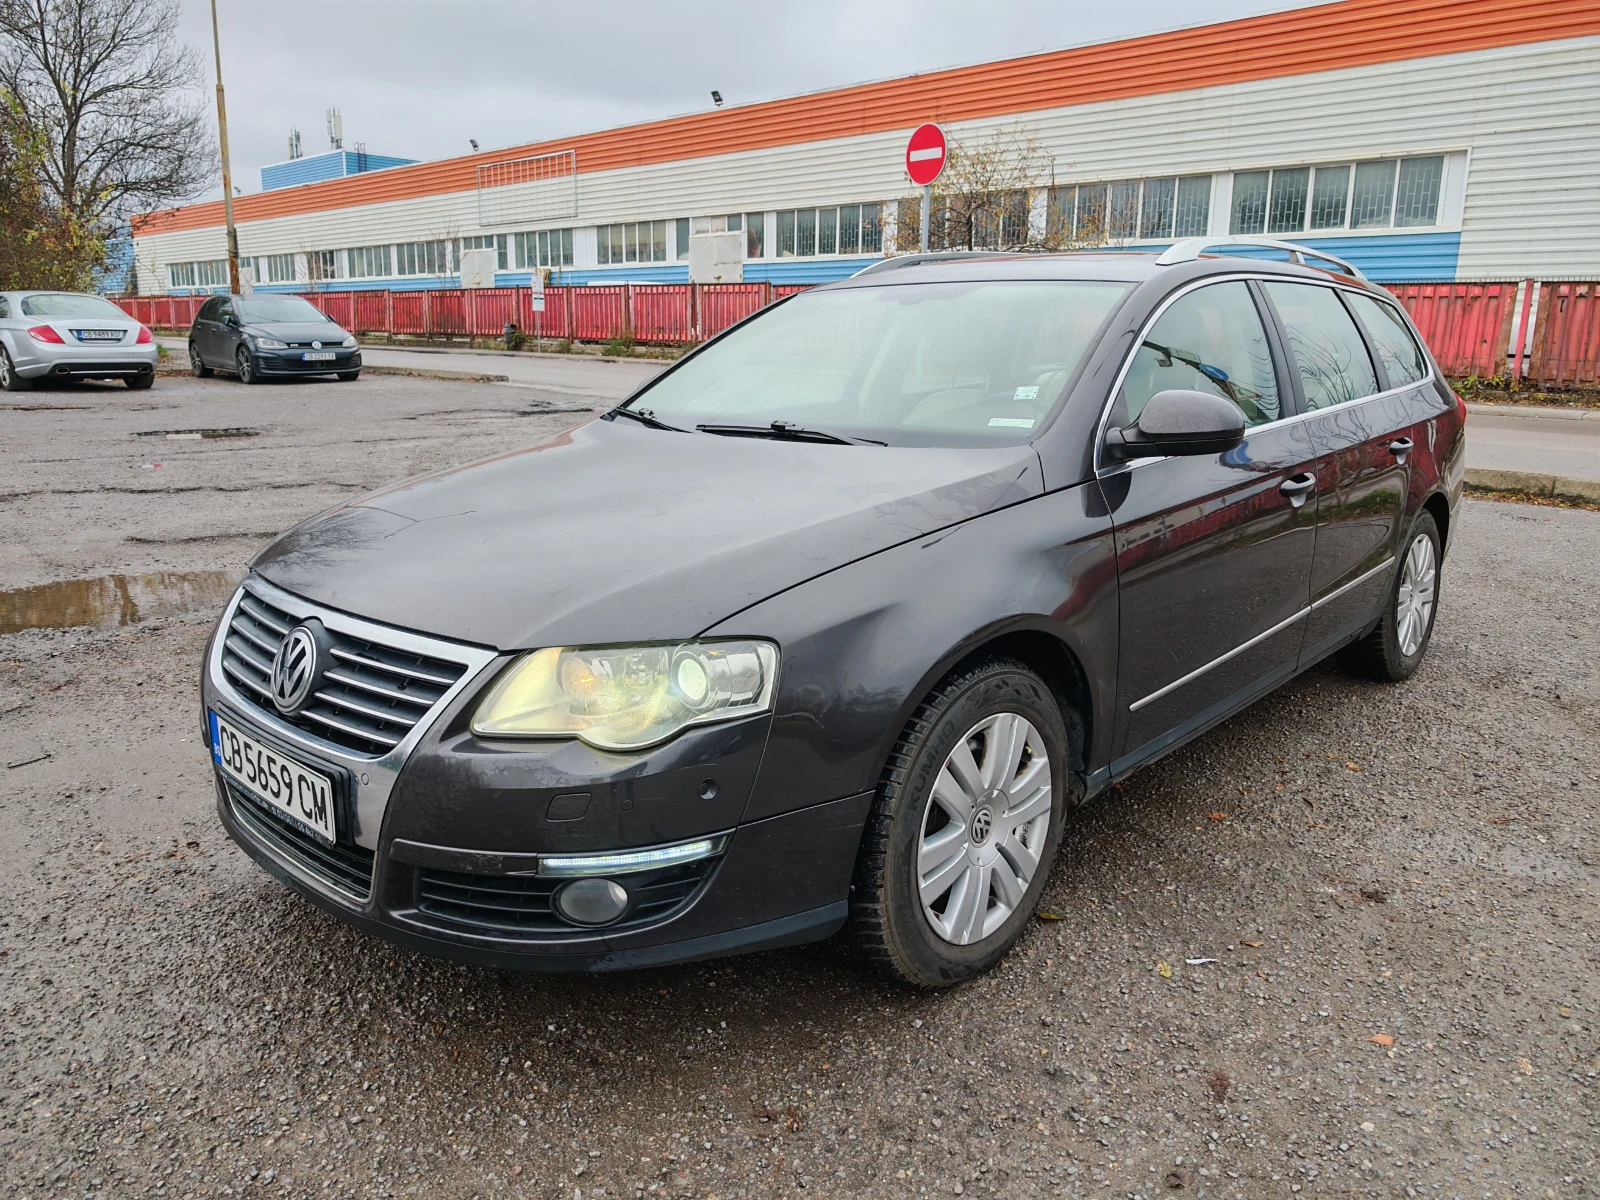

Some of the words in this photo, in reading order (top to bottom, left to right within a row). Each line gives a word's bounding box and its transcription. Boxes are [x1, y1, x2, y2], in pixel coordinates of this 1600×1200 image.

[219, 725, 243, 774] CB
[244, 740, 293, 807] 5659
[297, 773, 329, 831] CM
[907, 720, 955, 811] KUMHO
